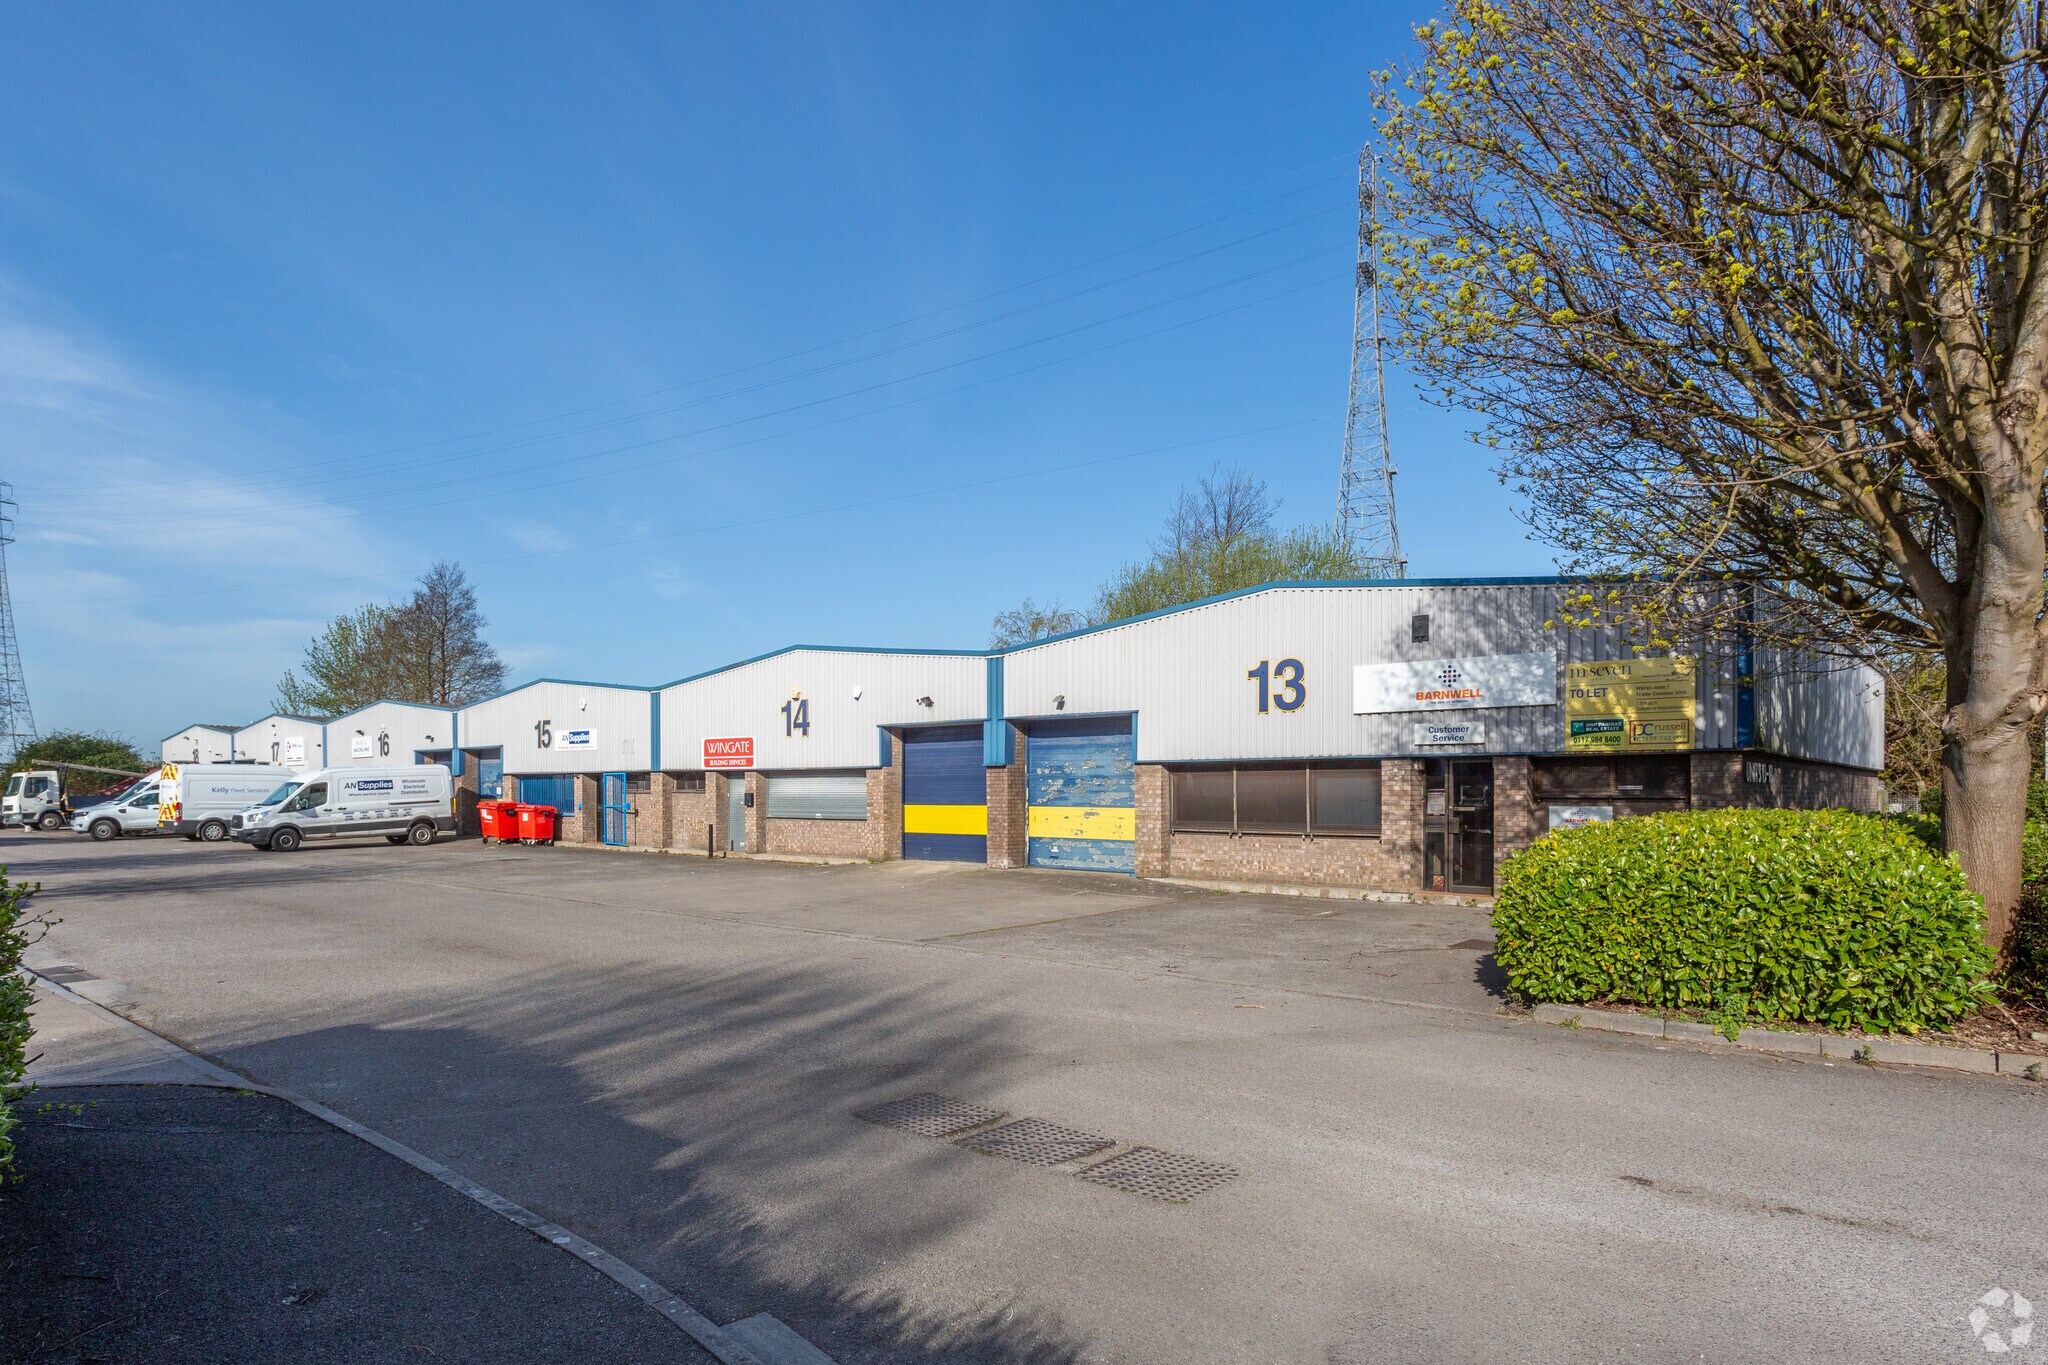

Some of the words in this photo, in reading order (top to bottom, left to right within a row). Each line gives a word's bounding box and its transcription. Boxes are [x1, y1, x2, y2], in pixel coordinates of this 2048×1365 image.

[1247, 657, 1308, 715] 13
[1416, 688, 1483, 700] BARNWELL
[1569, 688, 1585, 699] TO
[1586, 687, 1608, 698] LET
[780, 699, 811, 738] 14
[1428, 726, 1470, 734] Customer
[1654, 721, 1686, 731] russell
[534, 719, 552, 749] 15
[1432, 734, 1465, 742] Service
[1604, 735, 1621, 743] 8400
[377, 733, 390, 757] 16
[706, 741, 750, 754] WINGATE
[271, 741, 280, 762] 17
[344, 782, 357, 790] AN
[358, 781, 393, 790] Supplies
